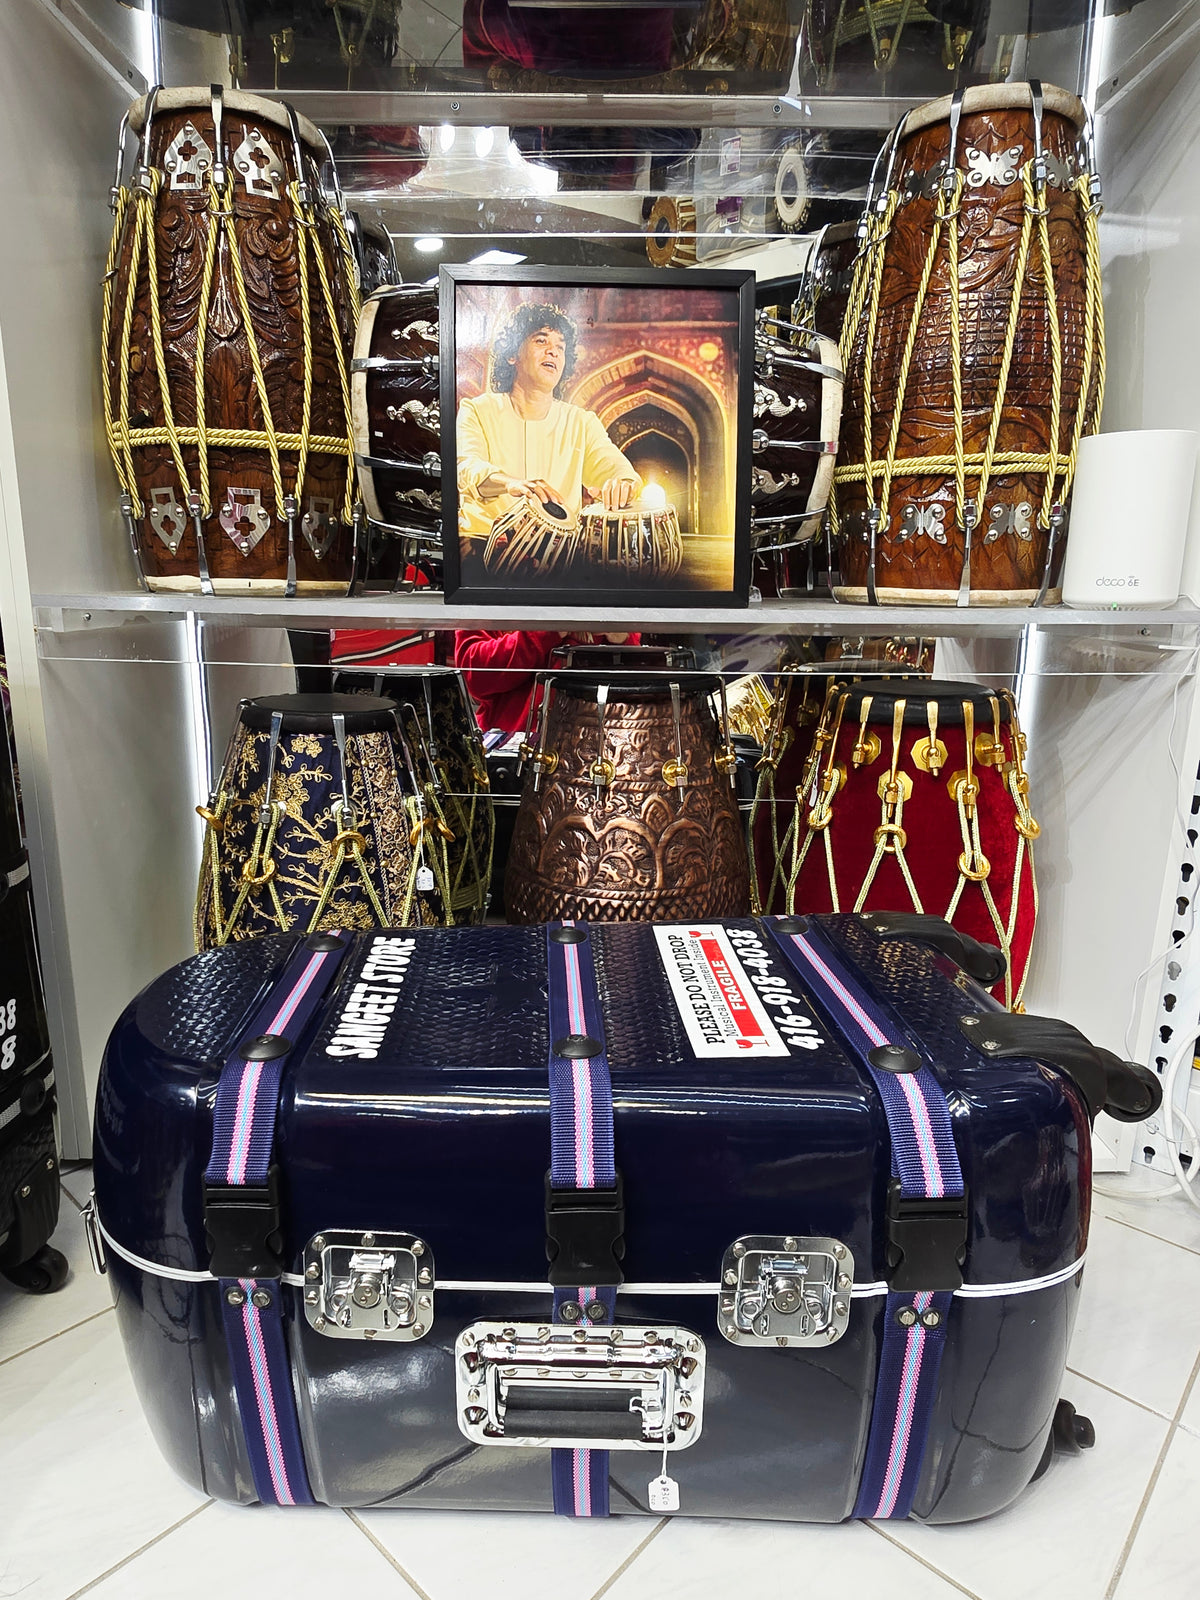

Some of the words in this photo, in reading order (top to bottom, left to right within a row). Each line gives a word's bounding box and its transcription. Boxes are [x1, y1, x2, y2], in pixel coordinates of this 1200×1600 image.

[1096, 576, 1126, 587] deco
[360, 936, 417, 984] STORE
[668, 934, 690, 961] DROP
[689, 939, 705, 961] Inside
[677, 961, 699, 983] NOT
[699, 962, 723, 1003] Instrument
[711, 960, 747, 1011] FRAGILE
[726, 928, 825, 1051] 416-918-4038
[686, 984, 706, 1001] DO
[325, 983, 401, 1059] SANGEET
[692, 1002, 726, 1044] PLEASE
[717, 1004, 739, 1037] Musical
